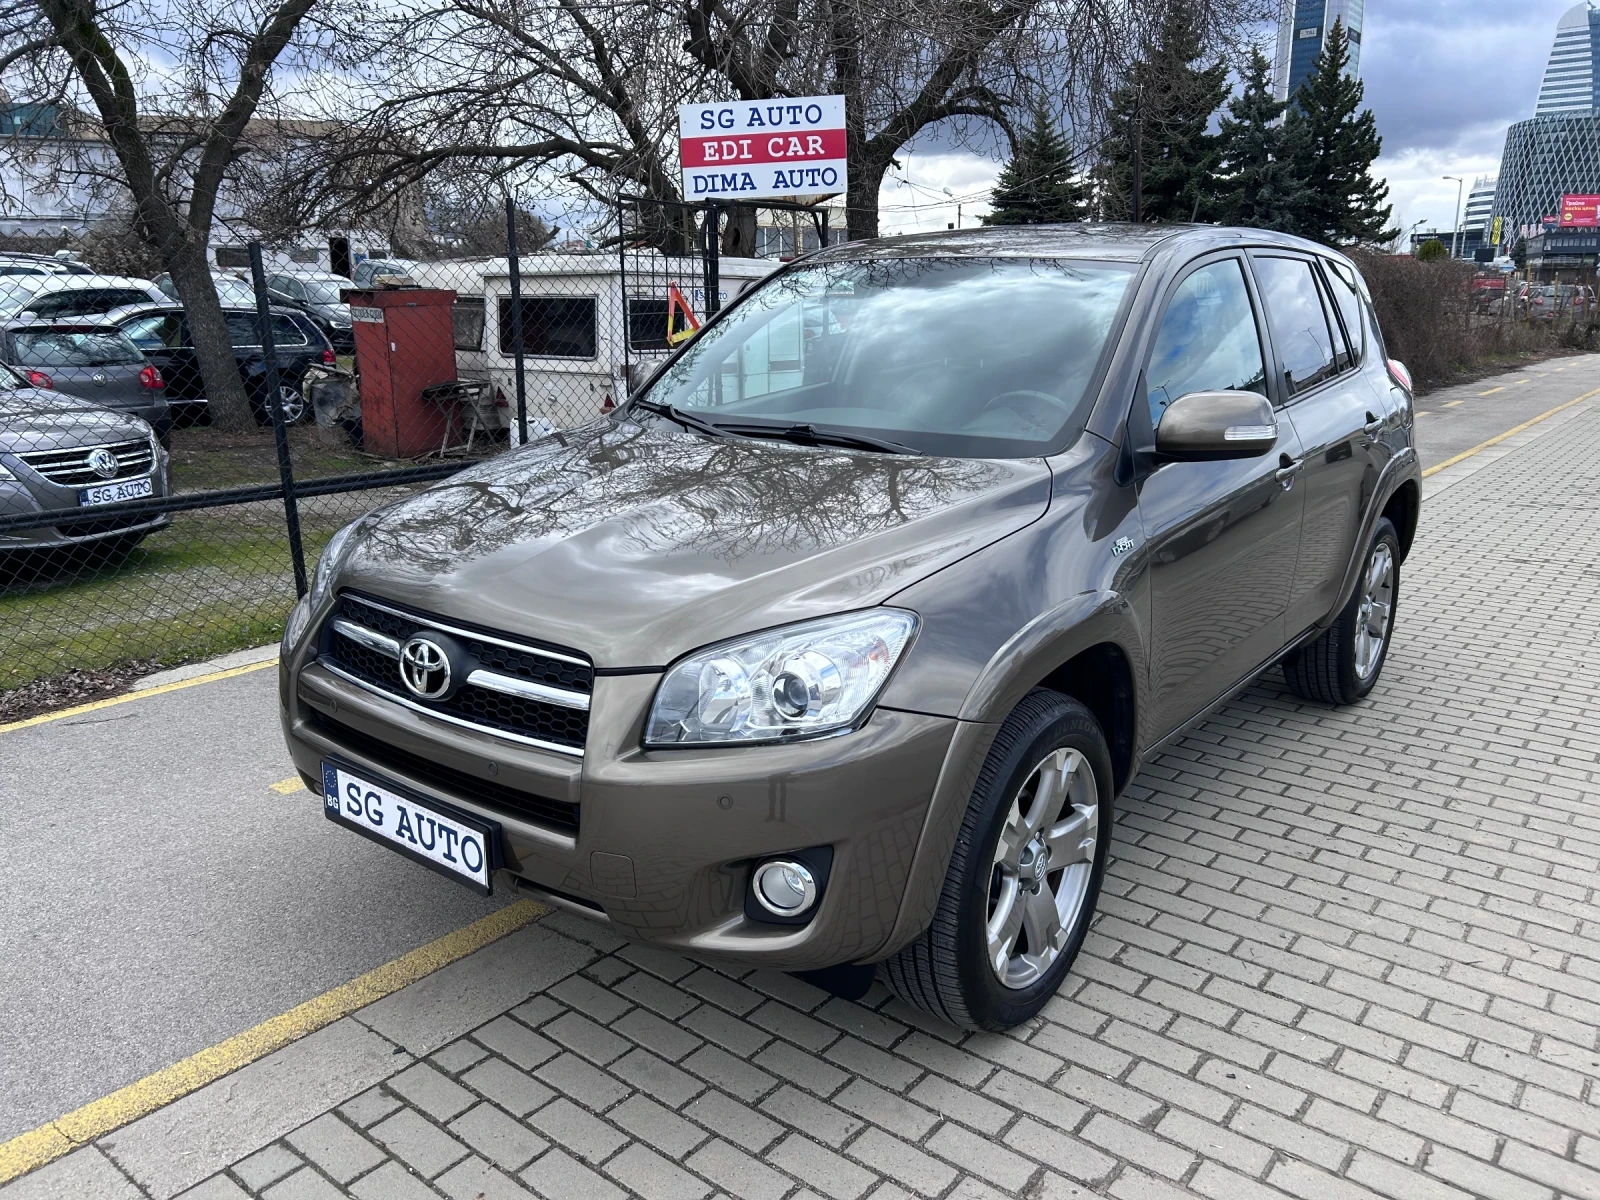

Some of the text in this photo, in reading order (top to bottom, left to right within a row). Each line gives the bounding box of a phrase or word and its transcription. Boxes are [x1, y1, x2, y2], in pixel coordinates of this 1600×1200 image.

[700, 104, 823, 130] SG AUTO
[702, 135, 825, 161] EDI CAR
[692, 167, 838, 194] DIMA AUTO
[92, 480, 152, 503] SG AUTO
[1054, 719, 1097, 737] DUNLOP
[326, 793, 339, 810] BG
[346, 782, 483, 873] SG AUTO
